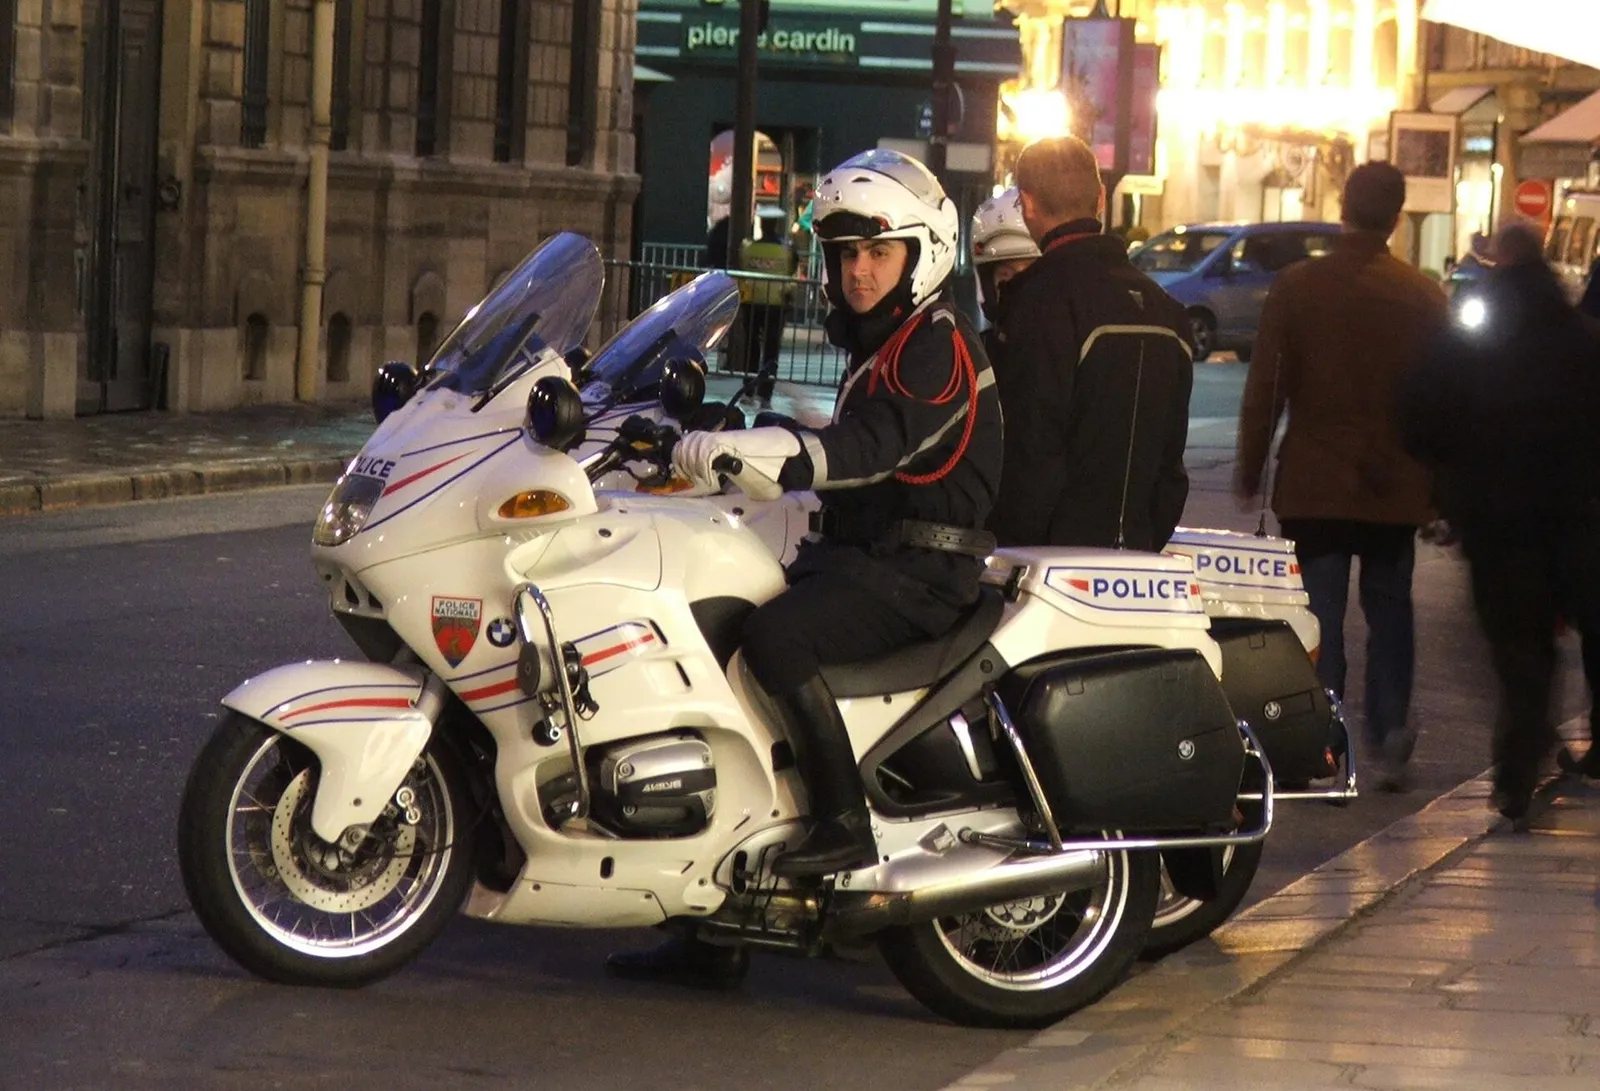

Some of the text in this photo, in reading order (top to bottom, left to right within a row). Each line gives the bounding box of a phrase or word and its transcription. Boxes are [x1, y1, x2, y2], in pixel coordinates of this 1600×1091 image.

[687, 22, 856, 52] piere cardin
[1196, 553, 1288, 577] POLICE
[1093, 577, 1189, 599] POLICE
[435, 607, 479, 617] NATIONALE
[439, 600, 476, 610] POLICE
